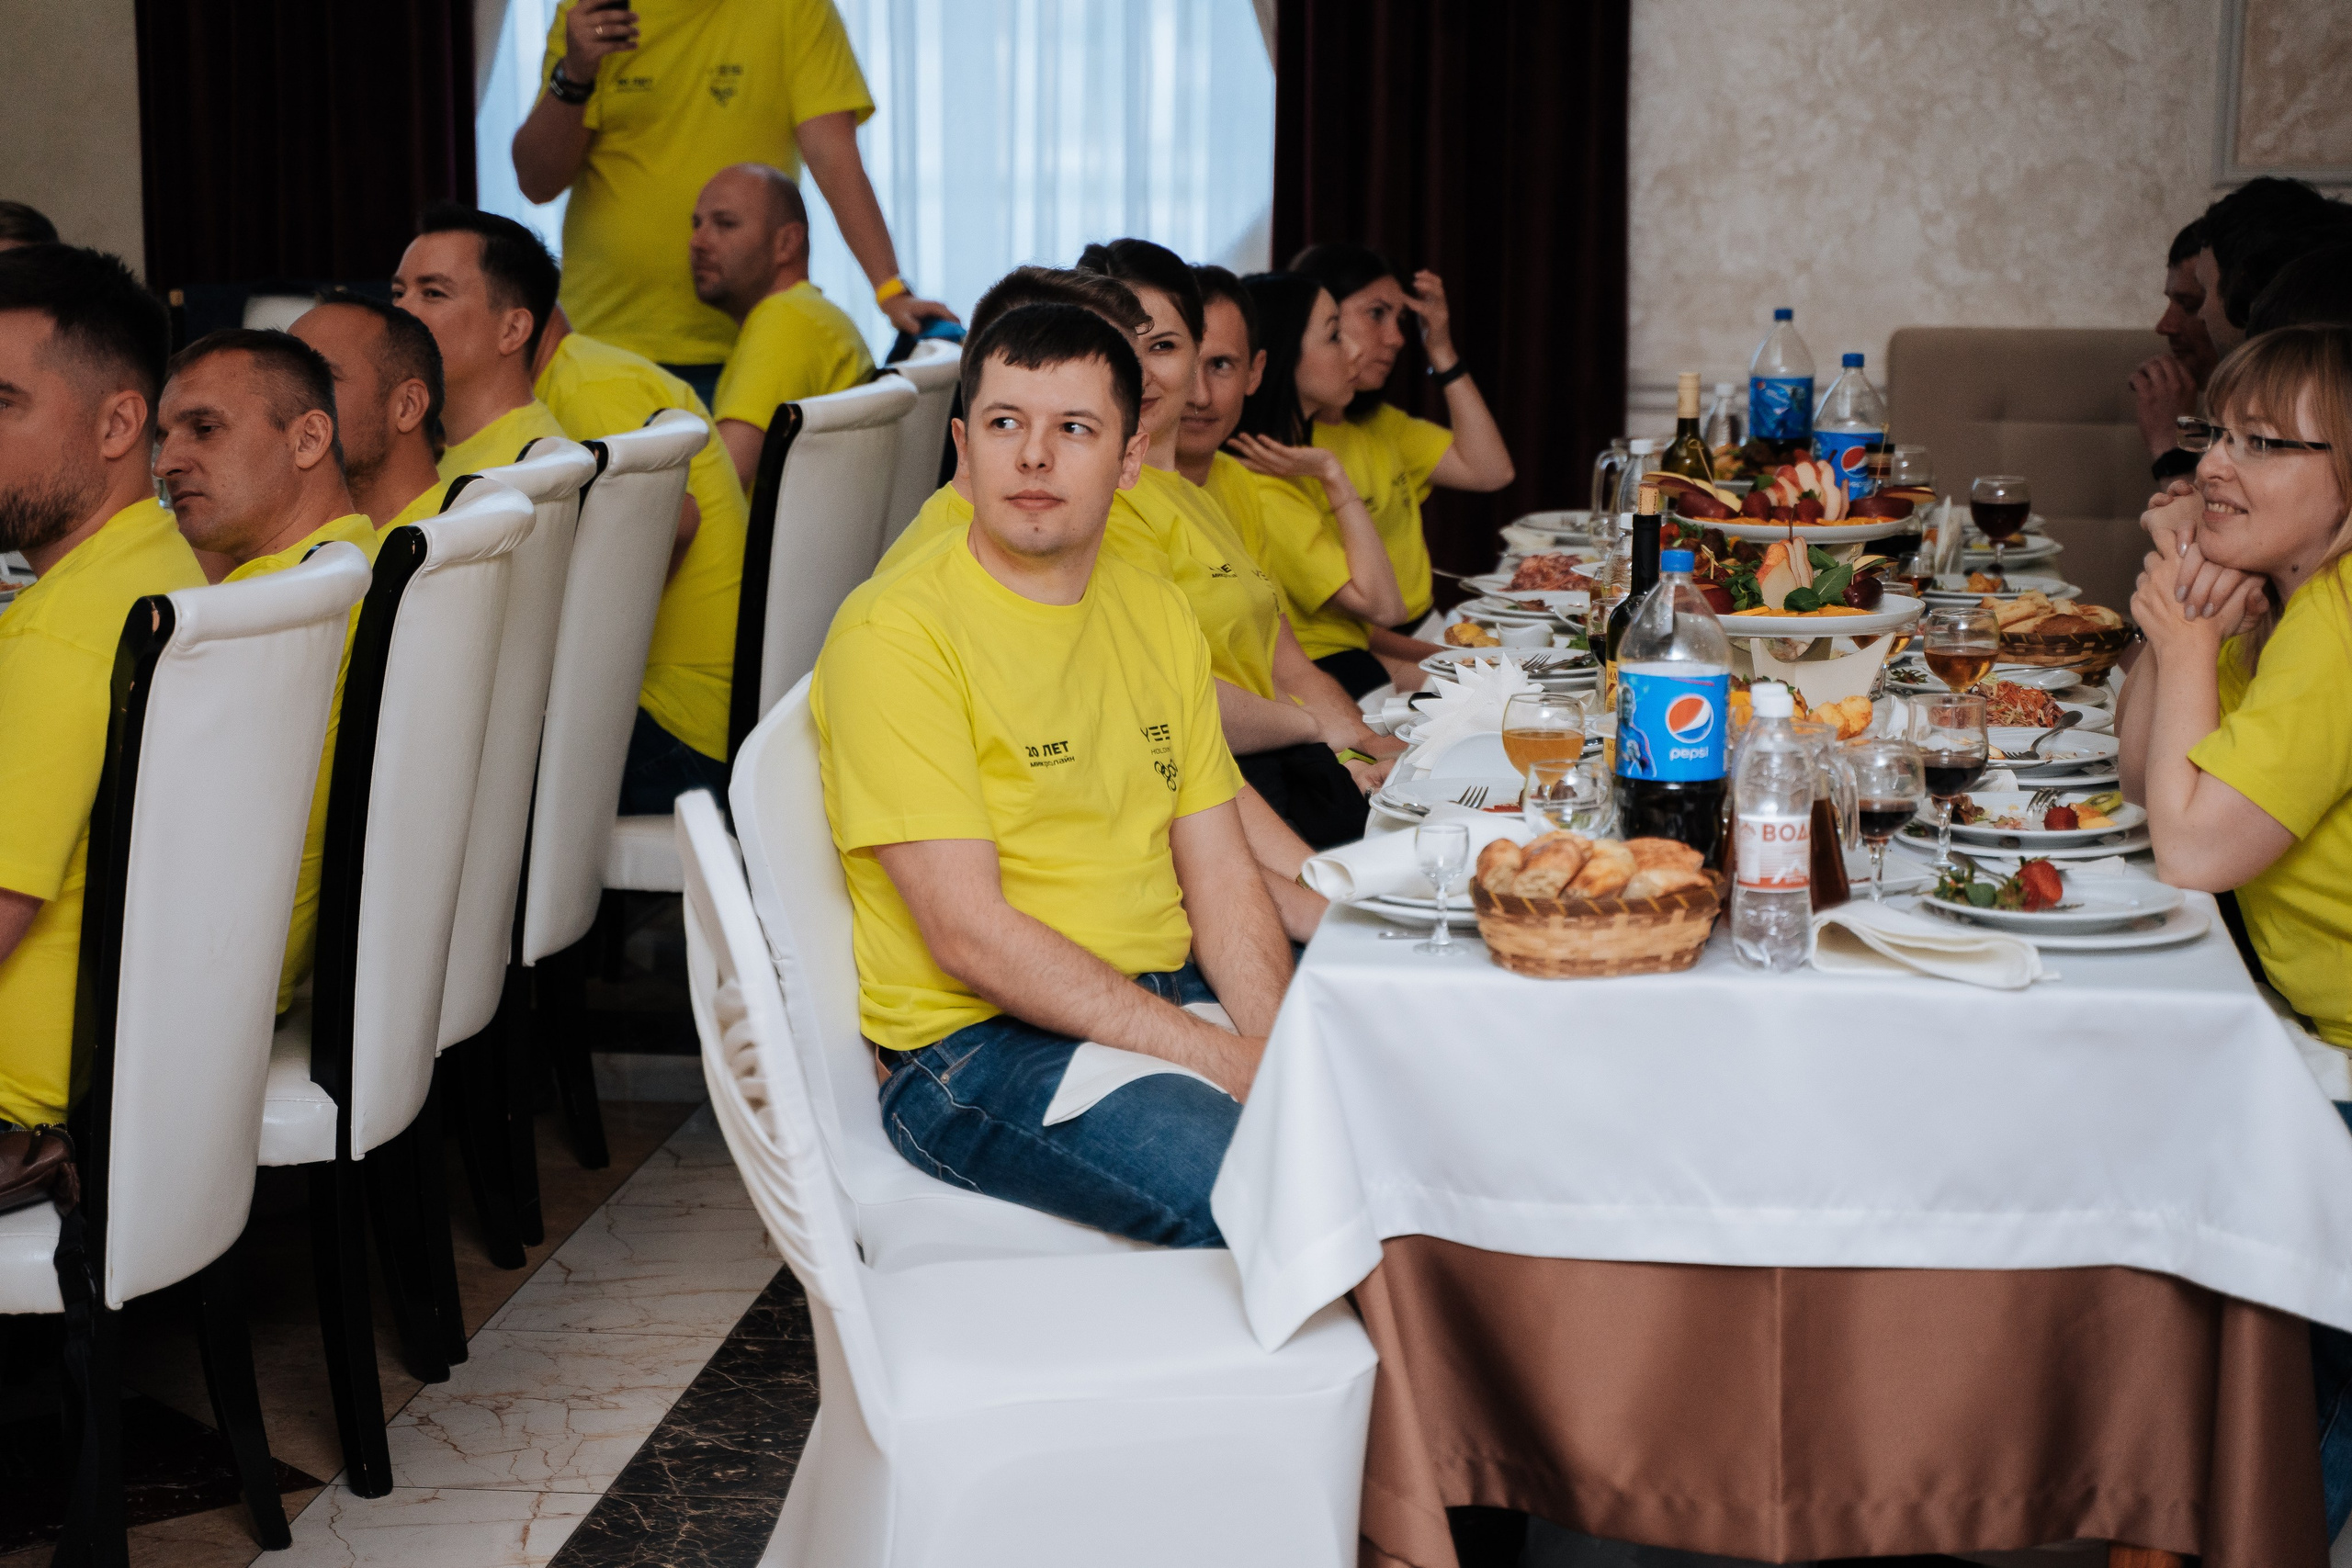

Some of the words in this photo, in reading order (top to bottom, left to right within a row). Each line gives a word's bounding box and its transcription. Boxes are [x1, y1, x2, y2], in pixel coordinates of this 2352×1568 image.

[1140, 724, 1170, 743] YES
[1025, 746, 1039, 758] 20
[1042, 740, 1069, 757] ЛЕТ
[1669, 746, 1709, 761] pepsi
